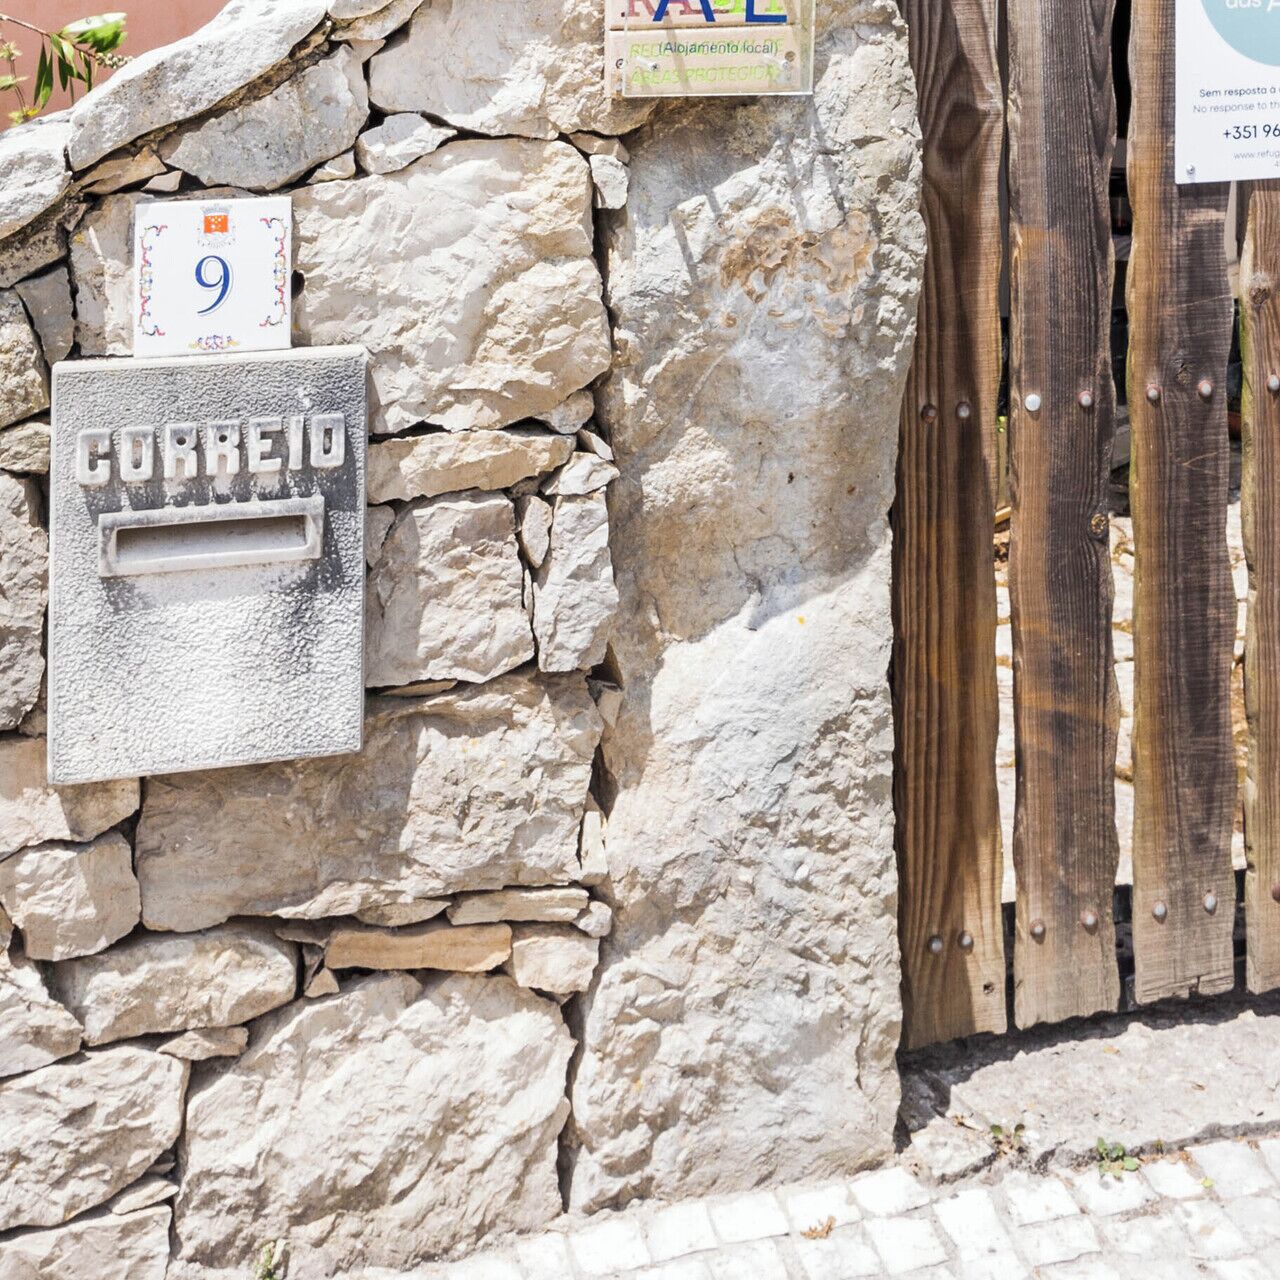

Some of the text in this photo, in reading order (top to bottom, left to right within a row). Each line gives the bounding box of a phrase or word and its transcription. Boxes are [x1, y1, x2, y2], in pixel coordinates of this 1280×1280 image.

[1199, 88, 1221, 98] Sem
[1224, 87, 1267, 98] resposta
[1193, 104, 1208, 114] No
[1210, 102, 1255, 114] response
[1257, 101, 1268, 110] to
[1223, 125, 1258, 140] +351
[195, 255, 233, 317] 9
[76, 412, 348, 487] CORREIO
